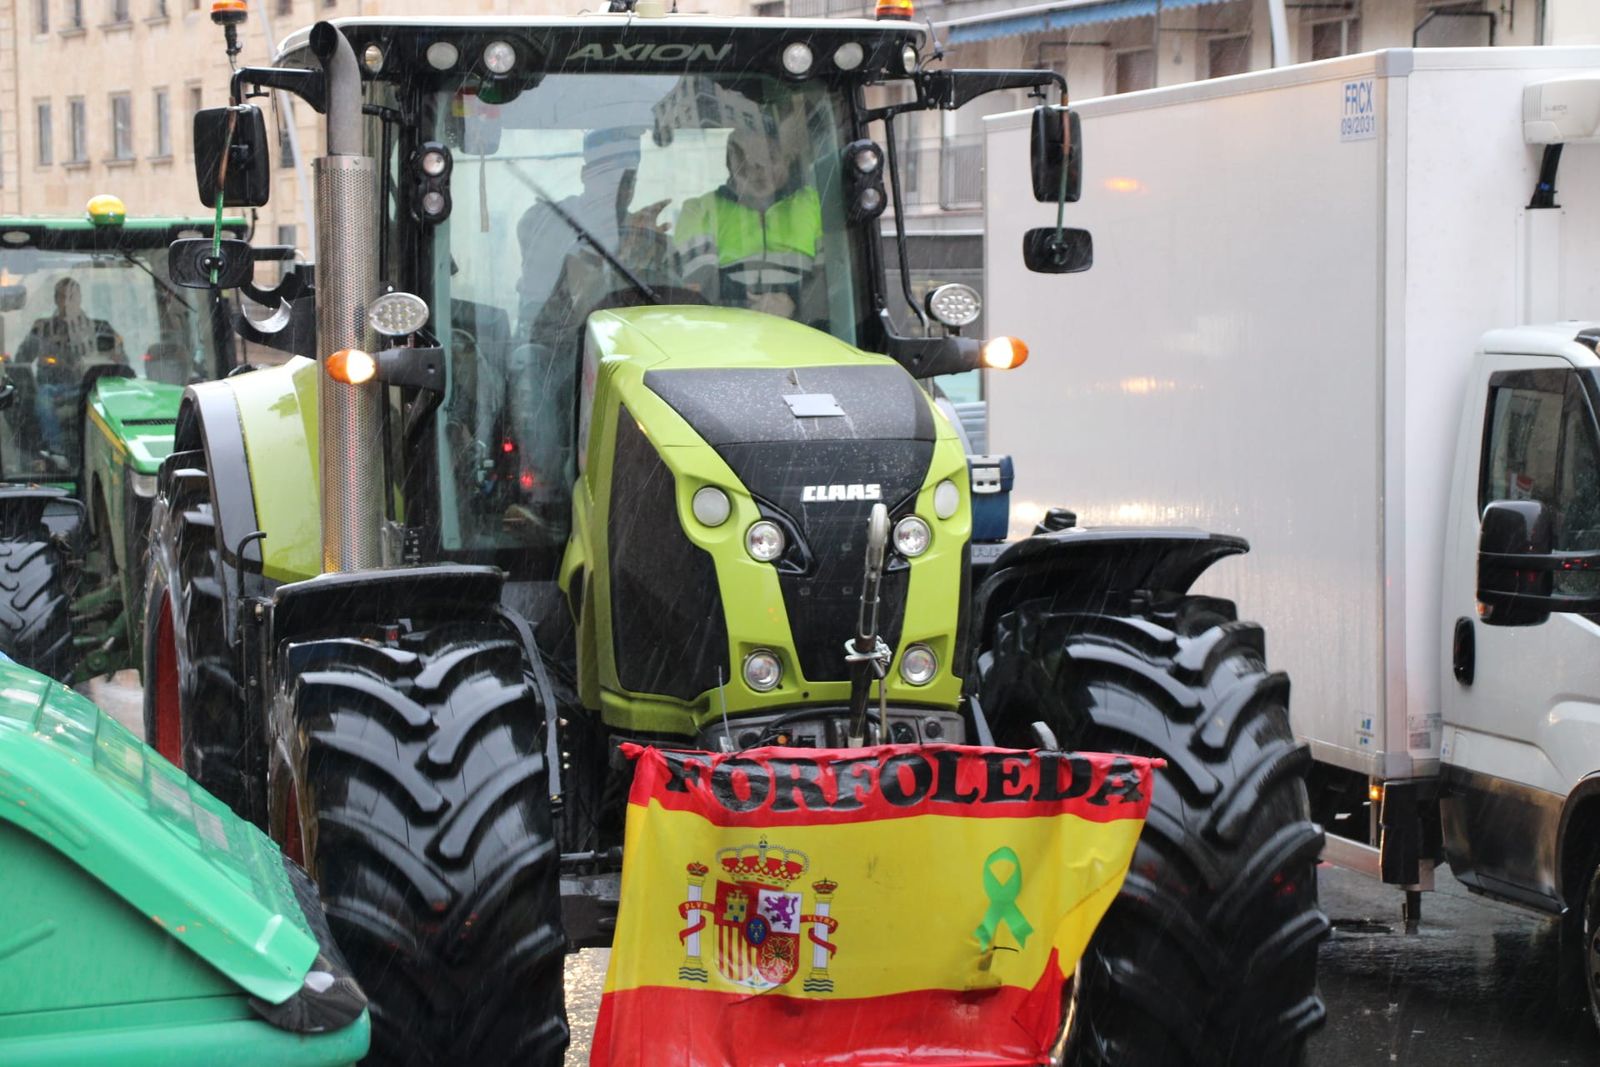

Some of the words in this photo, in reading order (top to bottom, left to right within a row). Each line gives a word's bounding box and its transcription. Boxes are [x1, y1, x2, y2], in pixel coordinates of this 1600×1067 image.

[567, 43, 732, 61] AXION
[1344, 81, 1373, 115] FRCX
[801, 483, 882, 502] CLAAS
[664, 750, 1145, 813] FORFOLEDA
